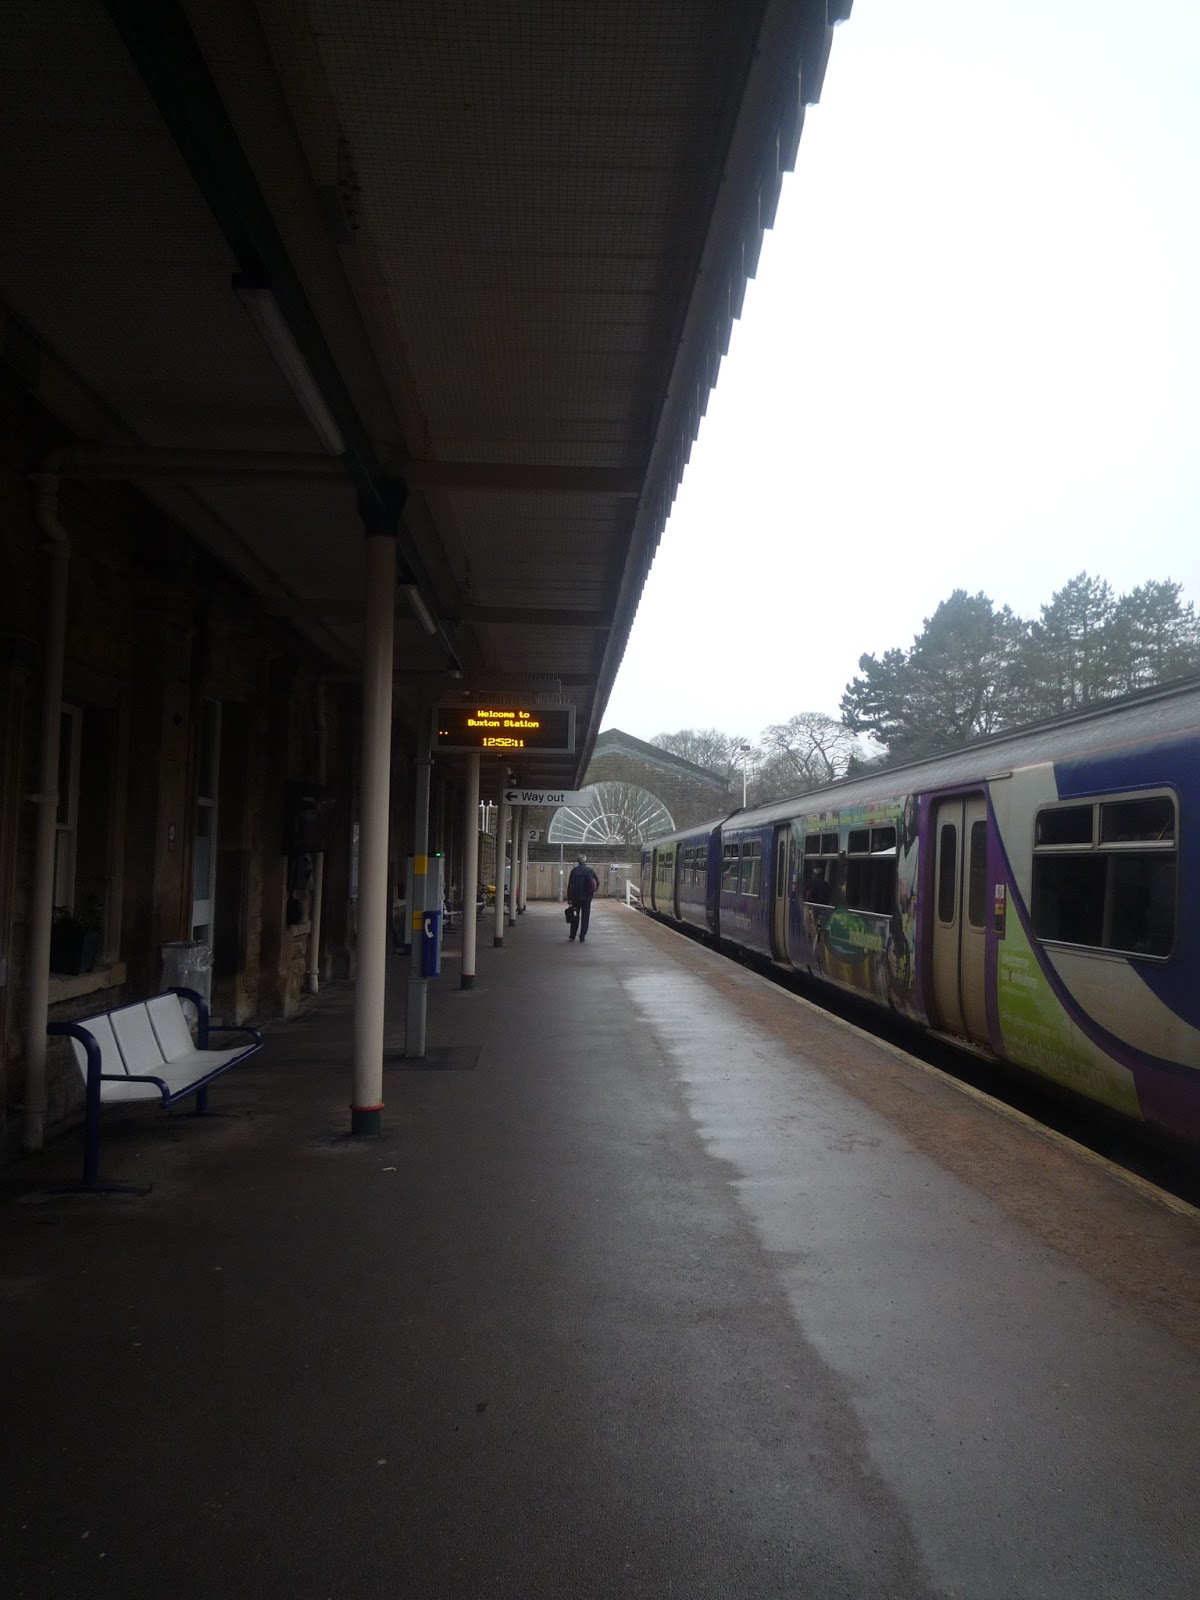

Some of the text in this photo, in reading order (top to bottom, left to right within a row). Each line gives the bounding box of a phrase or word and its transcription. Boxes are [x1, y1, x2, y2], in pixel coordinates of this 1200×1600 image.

[478, 710, 530, 718] Welcome to
[467, 719, 540, 728] Buxton Station
[482, 738, 524, 747] 12:52:11
[522, 791, 565, 805] Way out
[529, 830, 537, 839] 2
